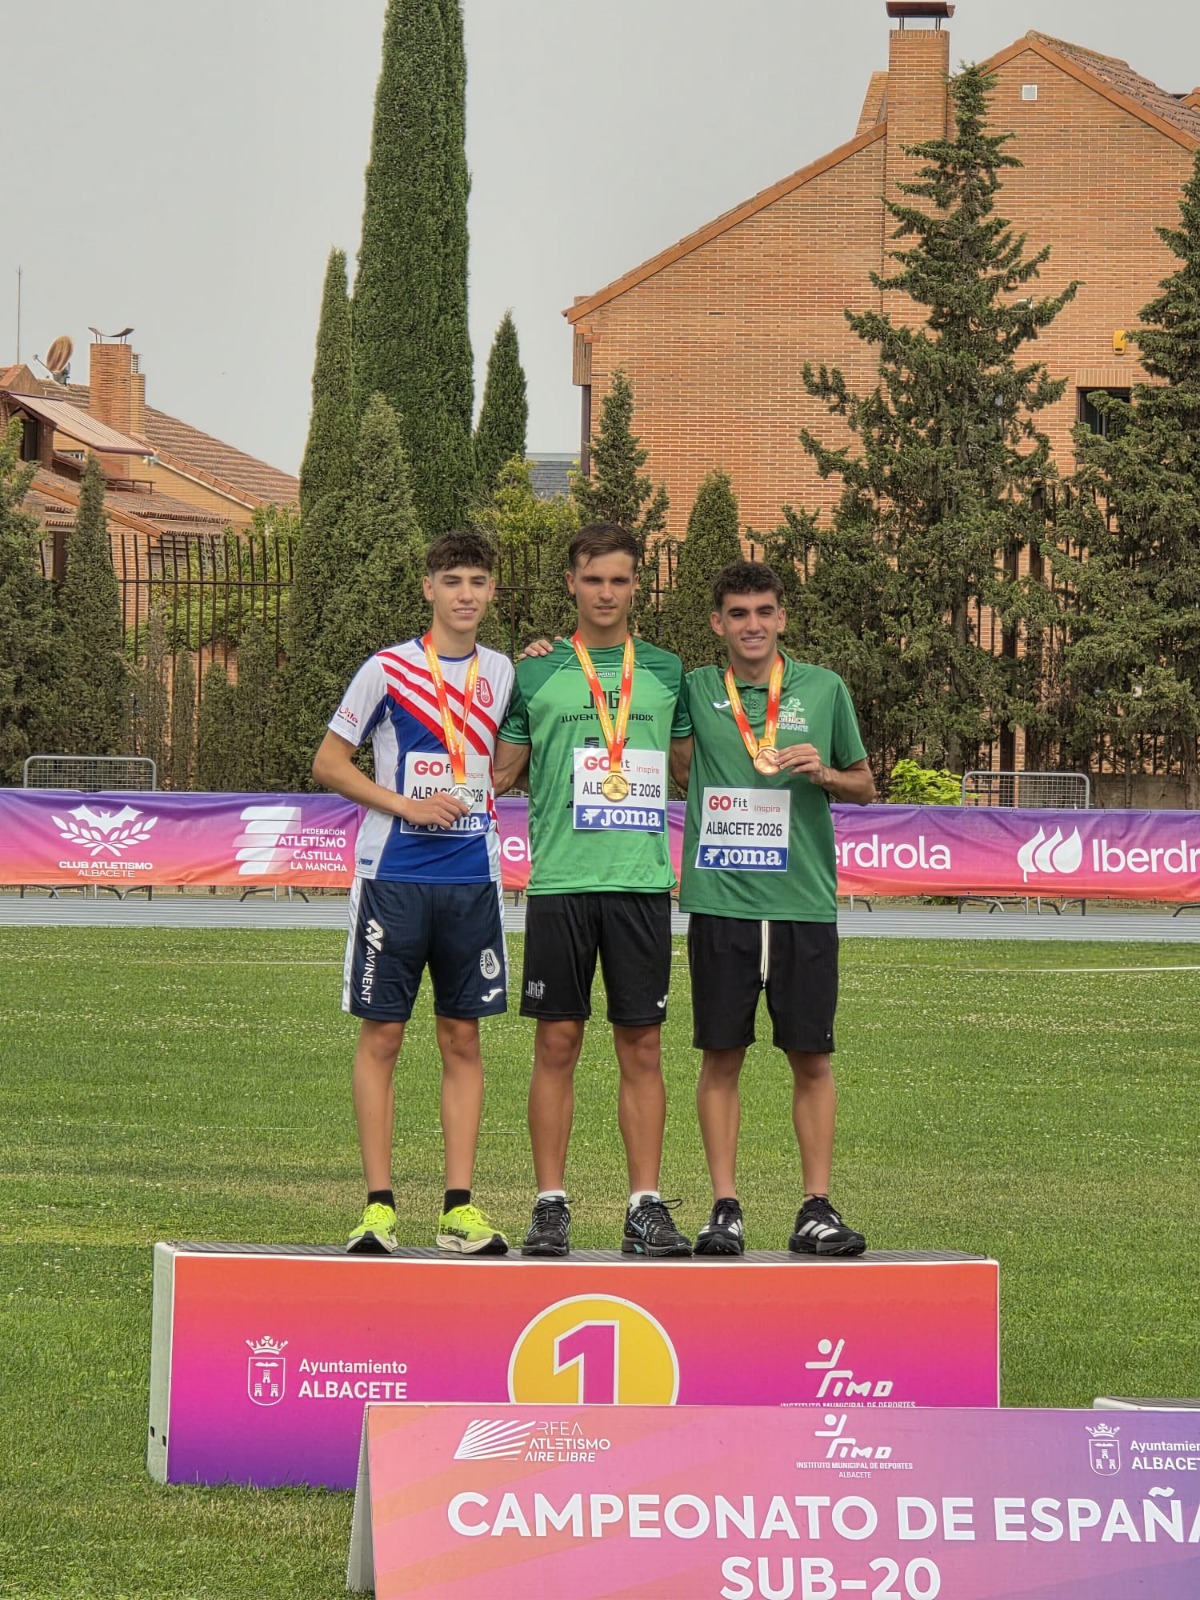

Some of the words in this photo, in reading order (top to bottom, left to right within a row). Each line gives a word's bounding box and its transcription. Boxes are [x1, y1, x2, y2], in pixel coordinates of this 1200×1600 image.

[560, 713, 615, 724] JUVENTD
[414, 760, 444, 777] GO
[638, 783, 661, 799] 2026
[708, 795, 732, 811] GO
[732, 797, 749, 812] fit
[705, 821, 755, 836] ALBACETE
[756, 822, 783, 837] 2026
[278, 835, 347, 848] ATLETISMO
[293, 850, 343, 862] CASTILLA
[835, 834, 952, 870] rdrola
[58, 861, 89, 869] CLUB
[90, 861, 153, 870] ATLETISMO
[290, 861, 303, 870] LA
[305, 862, 348, 872] MANCHA
[77, 869, 136, 878] ALBACETE
[361, 945, 376, 1004] AVINENT
[298, 1358, 407, 1376] Ayuntamiento
[553, 1319, 620, 1405] 1
[297, 1380, 408, 1400] ALBACETE
[536, 1421, 583, 1436] RFEA
[529, 1437, 611, 1450] ATLETISMO
[524, 1451, 555, 1462] AIRE
[557, 1451, 596, 1463] LIBRE
[831, 1462, 868, 1470] MUNICIPAL
[879, 1462, 913, 1470] DEPORTES
[838, 1471, 872, 1479] ALBACETE
[447, 1491, 878, 1541] CAMPEONATO
[896, 1497, 976, 1541] DE
[719, 1556, 941, 1600] SUB-20
